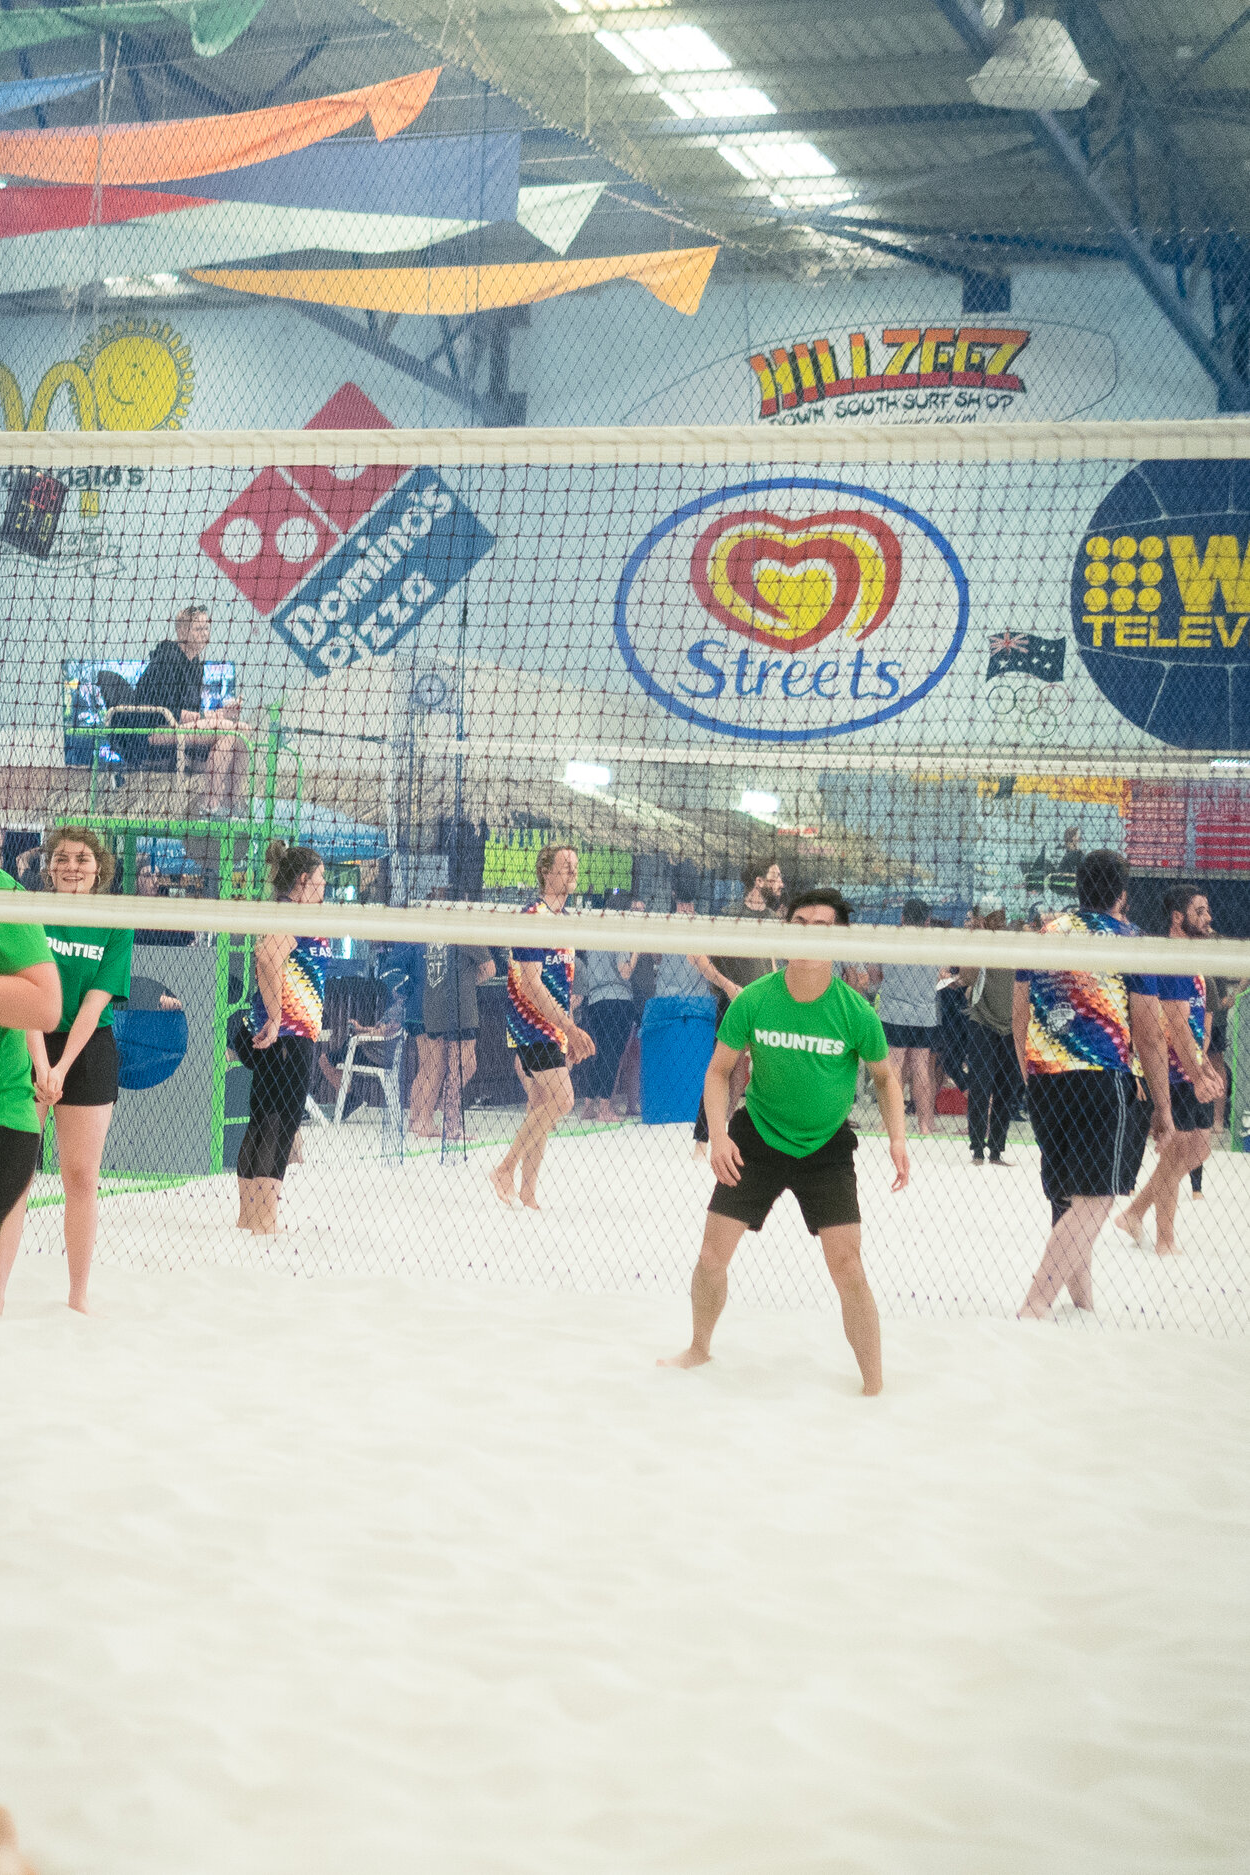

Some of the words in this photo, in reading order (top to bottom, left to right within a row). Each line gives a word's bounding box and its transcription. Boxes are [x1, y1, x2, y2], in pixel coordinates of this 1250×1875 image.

[835, 396, 899, 420] SOUTH
[902, 391, 953, 412] SURF
[283, 483, 452, 650] Domino's
[677, 639, 903, 699] Streets
[754, 1028, 846, 1056] MOUNTIES
